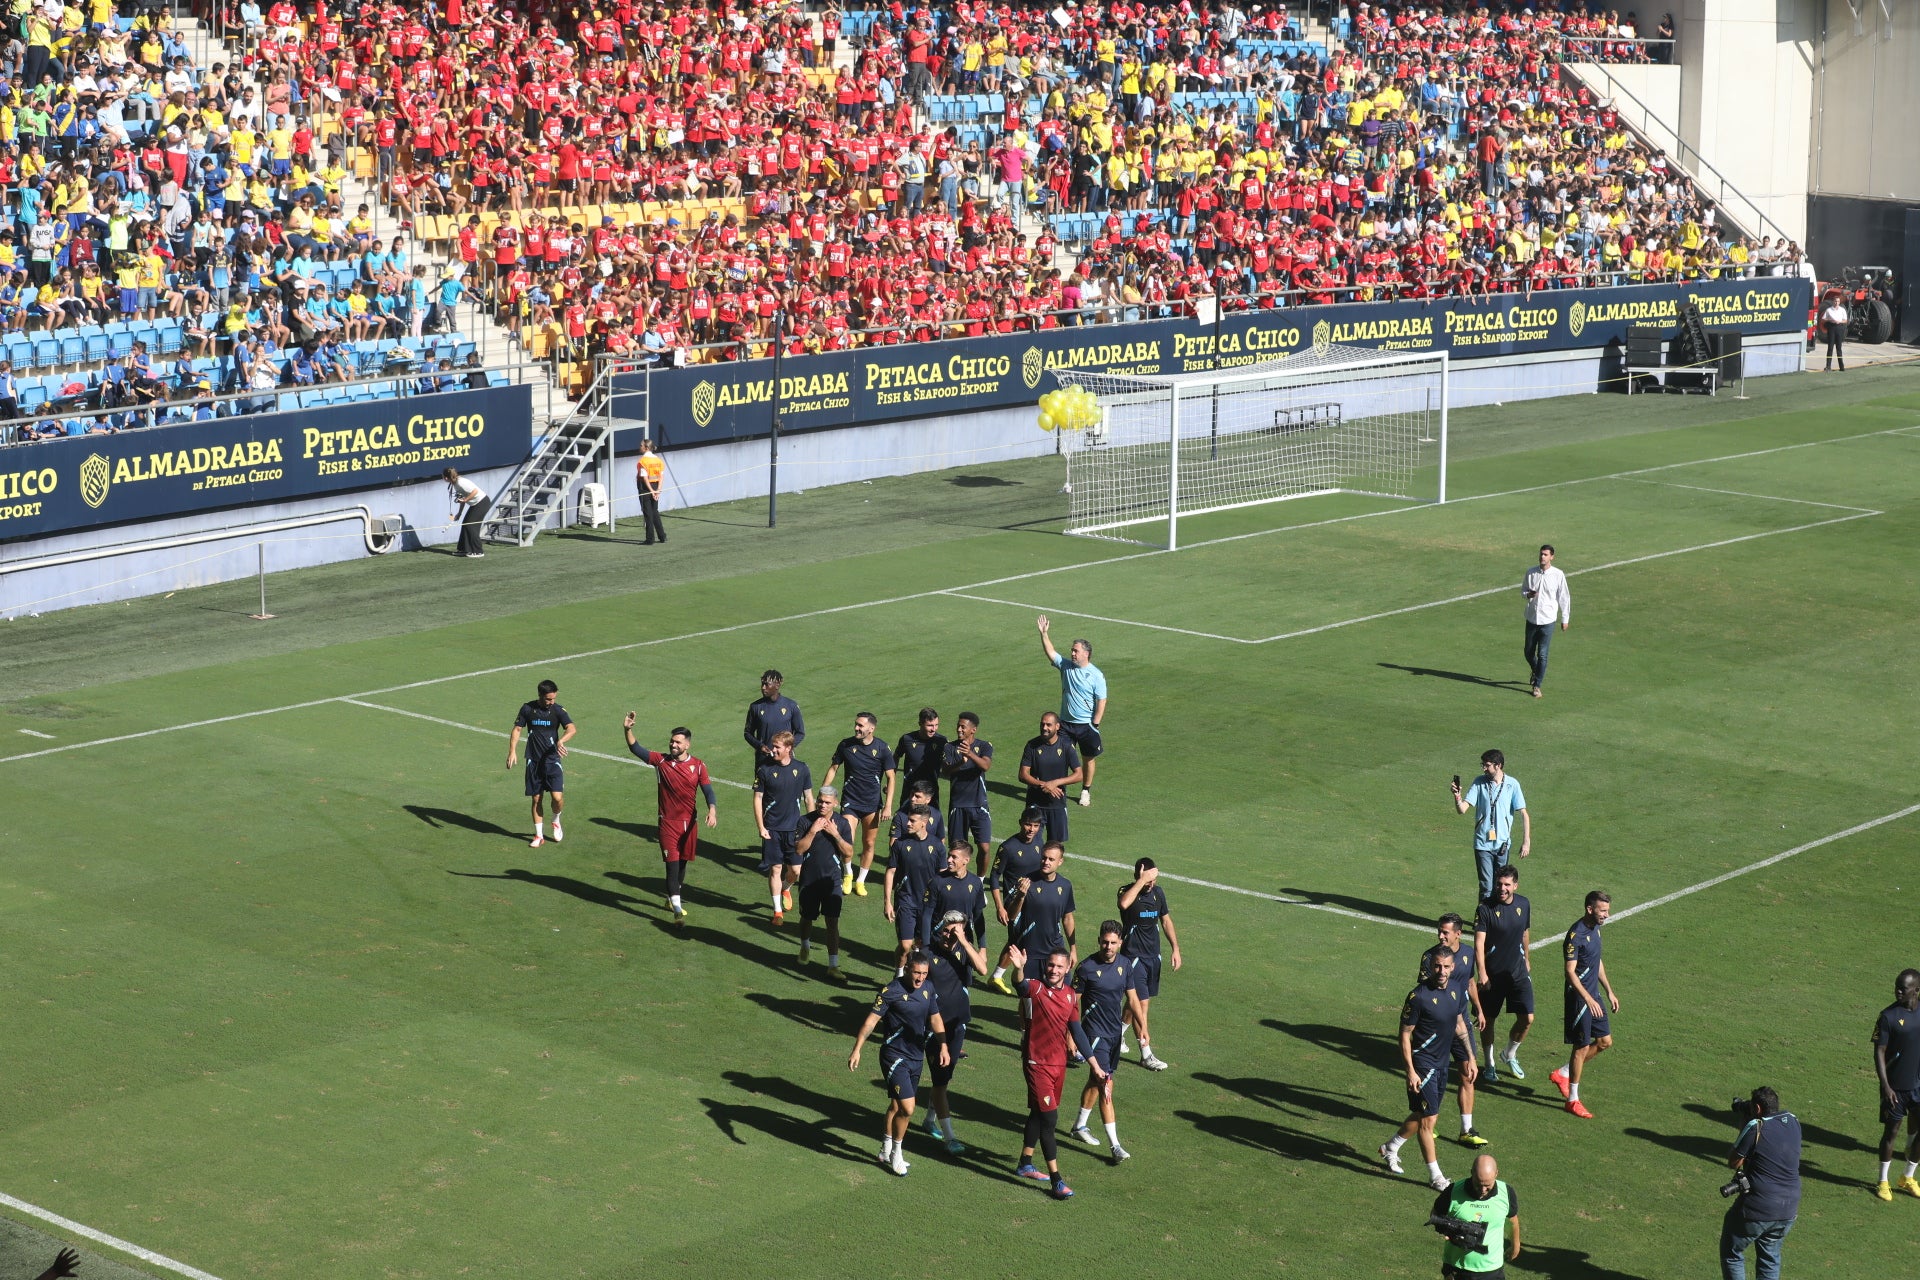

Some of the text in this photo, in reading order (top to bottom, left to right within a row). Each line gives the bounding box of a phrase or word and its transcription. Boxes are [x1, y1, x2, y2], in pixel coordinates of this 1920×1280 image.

[1586, 300, 1677, 322] ALMADRABA
[1745, 290, 1790, 311] CHICO
[1330, 317, 1433, 342] ALMADRABA
[1444, 306, 1558, 333] PETACA CHICO
[1702, 311, 1781, 326] SH & SEAFOOD EXPORT
[1173, 326, 1300, 358] PETACA CHICO
[1384, 340, 1411, 350] PETACA
[1411, 338, 1433, 348] CHICO
[1453, 330, 1549, 346] FISH & SEAFOOD EXPORT
[1043, 340, 1160, 371] ALMADRABA
[1183, 359, 1205, 371] FISH
[1206, 359, 1214, 369] &
[1218, 355, 1255, 369] EAFOOD
[865, 354, 1011, 390] PETACA CHICO
[1136, 364, 1160, 375] CHICO
[876, 381, 999, 405] FISH & SEAFOOD EXPORT
[788, 401, 822, 413] PETACA
[823, 397, 850, 409] CHICO
[302, 413, 485, 459] PETACA CHICO
[112, 438, 283, 484] ALMADRABA
[318, 444, 471, 475] FISH & SEAFOOD EXPORT
[204, 474, 246, 489] PETACA
[248, 468, 283, 483] CHICO
